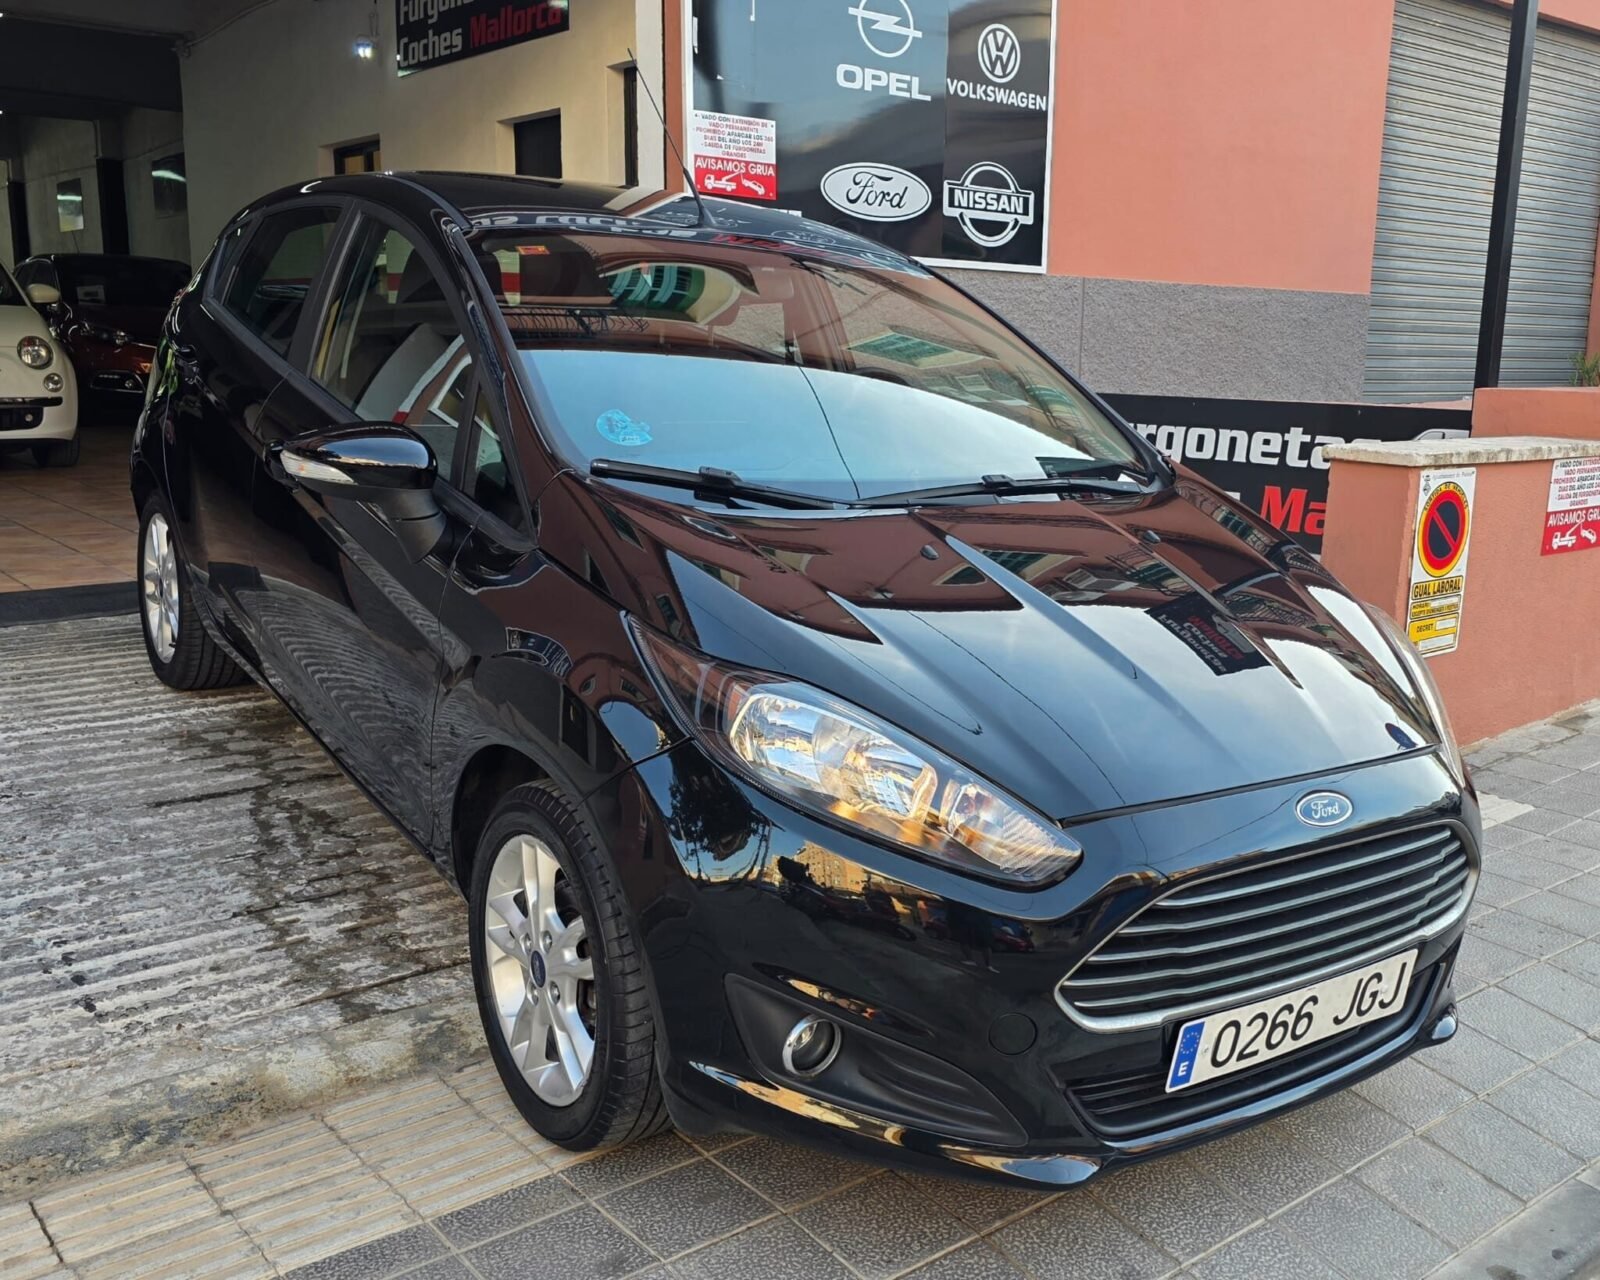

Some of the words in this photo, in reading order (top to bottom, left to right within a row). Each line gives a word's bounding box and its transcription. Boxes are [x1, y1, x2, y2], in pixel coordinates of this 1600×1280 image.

[400, 28, 463, 67] Coches
[470, 3, 562, 48] Mallorca
[836, 63, 931, 101] OPEL
[947, 78, 1047, 111] VOLKSWAGEN
[695, 157, 746, 173] AVISAMOS
[748, 163, 775, 177] GRUA
[846, 171, 908, 209] Ford
[953, 189, 1024, 214] NISSAN
[1547, 509, 1586, 527] AVISAMOS
[1414, 583, 1431, 598] GUAL
[1433, 579, 1461, 594] LABORAL
[1310, 799, 1341, 820] Ford
[1210, 994, 1319, 1068] 0266
[1332, 961, 1407, 1026] JGJ
[1176, 1061, 1191, 1077] E
